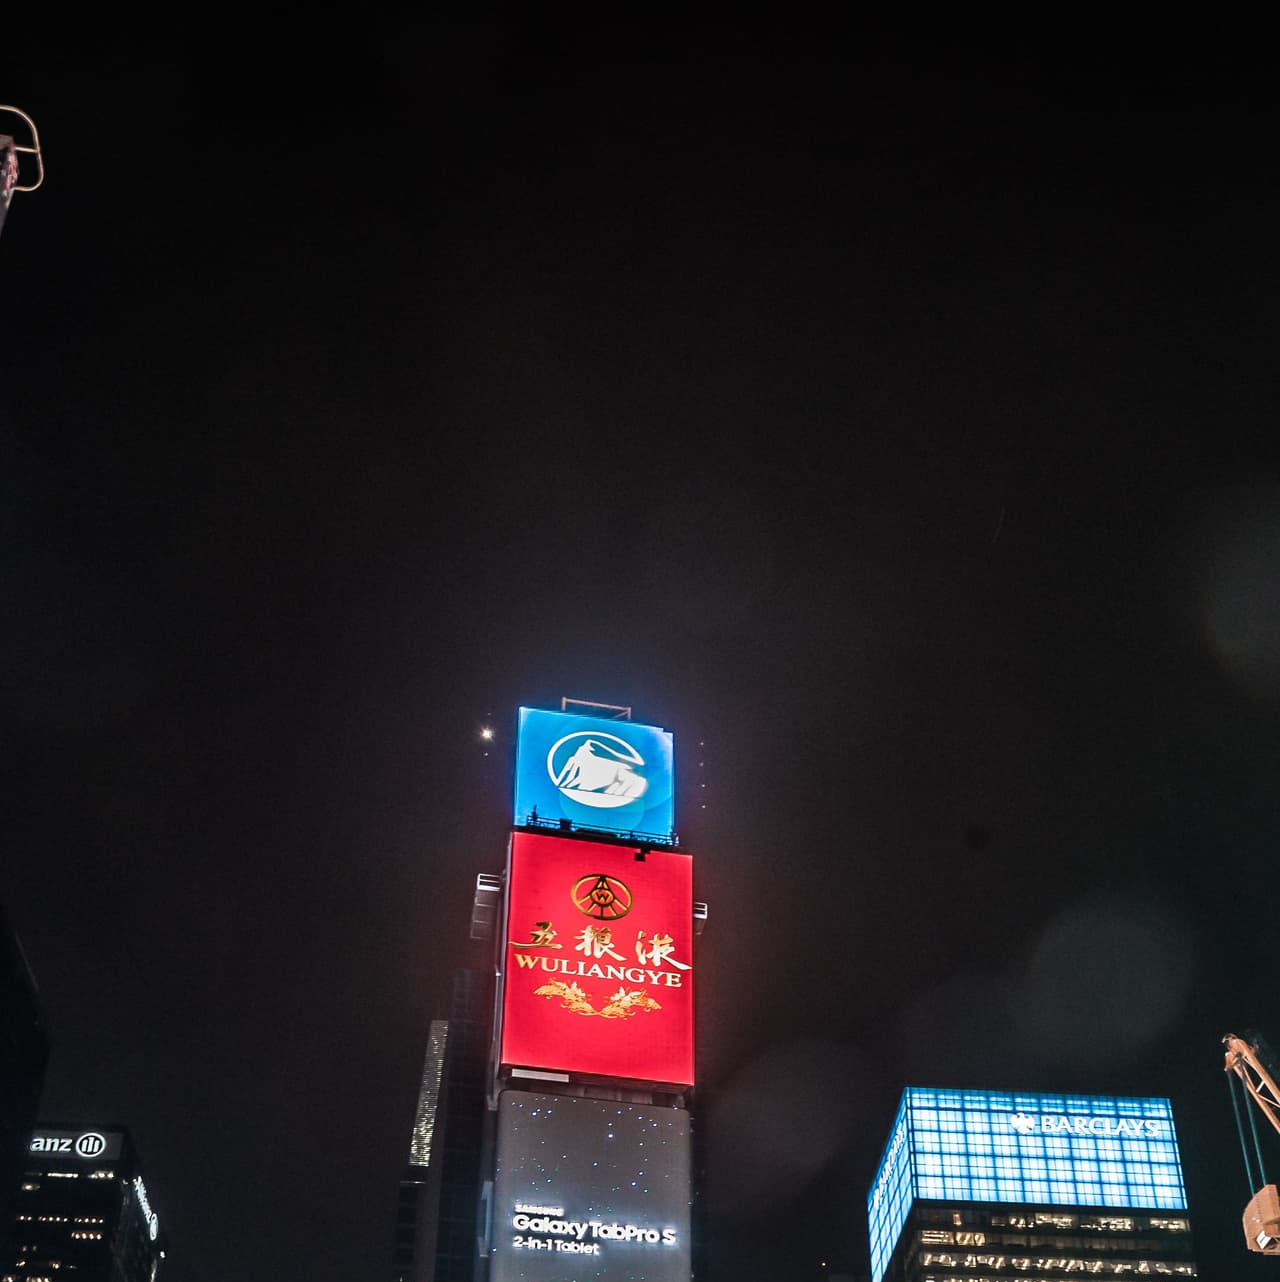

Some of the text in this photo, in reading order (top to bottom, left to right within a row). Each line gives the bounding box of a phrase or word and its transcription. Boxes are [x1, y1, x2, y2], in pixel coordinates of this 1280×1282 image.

[508, 921, 694, 971] 五粮液
[514, 953, 683, 989] WULIANGYE
[512, 1215, 677, 1246] Galaxy TabPro S
[512, 1236, 600, 1256] 2-in-1 Tablet
